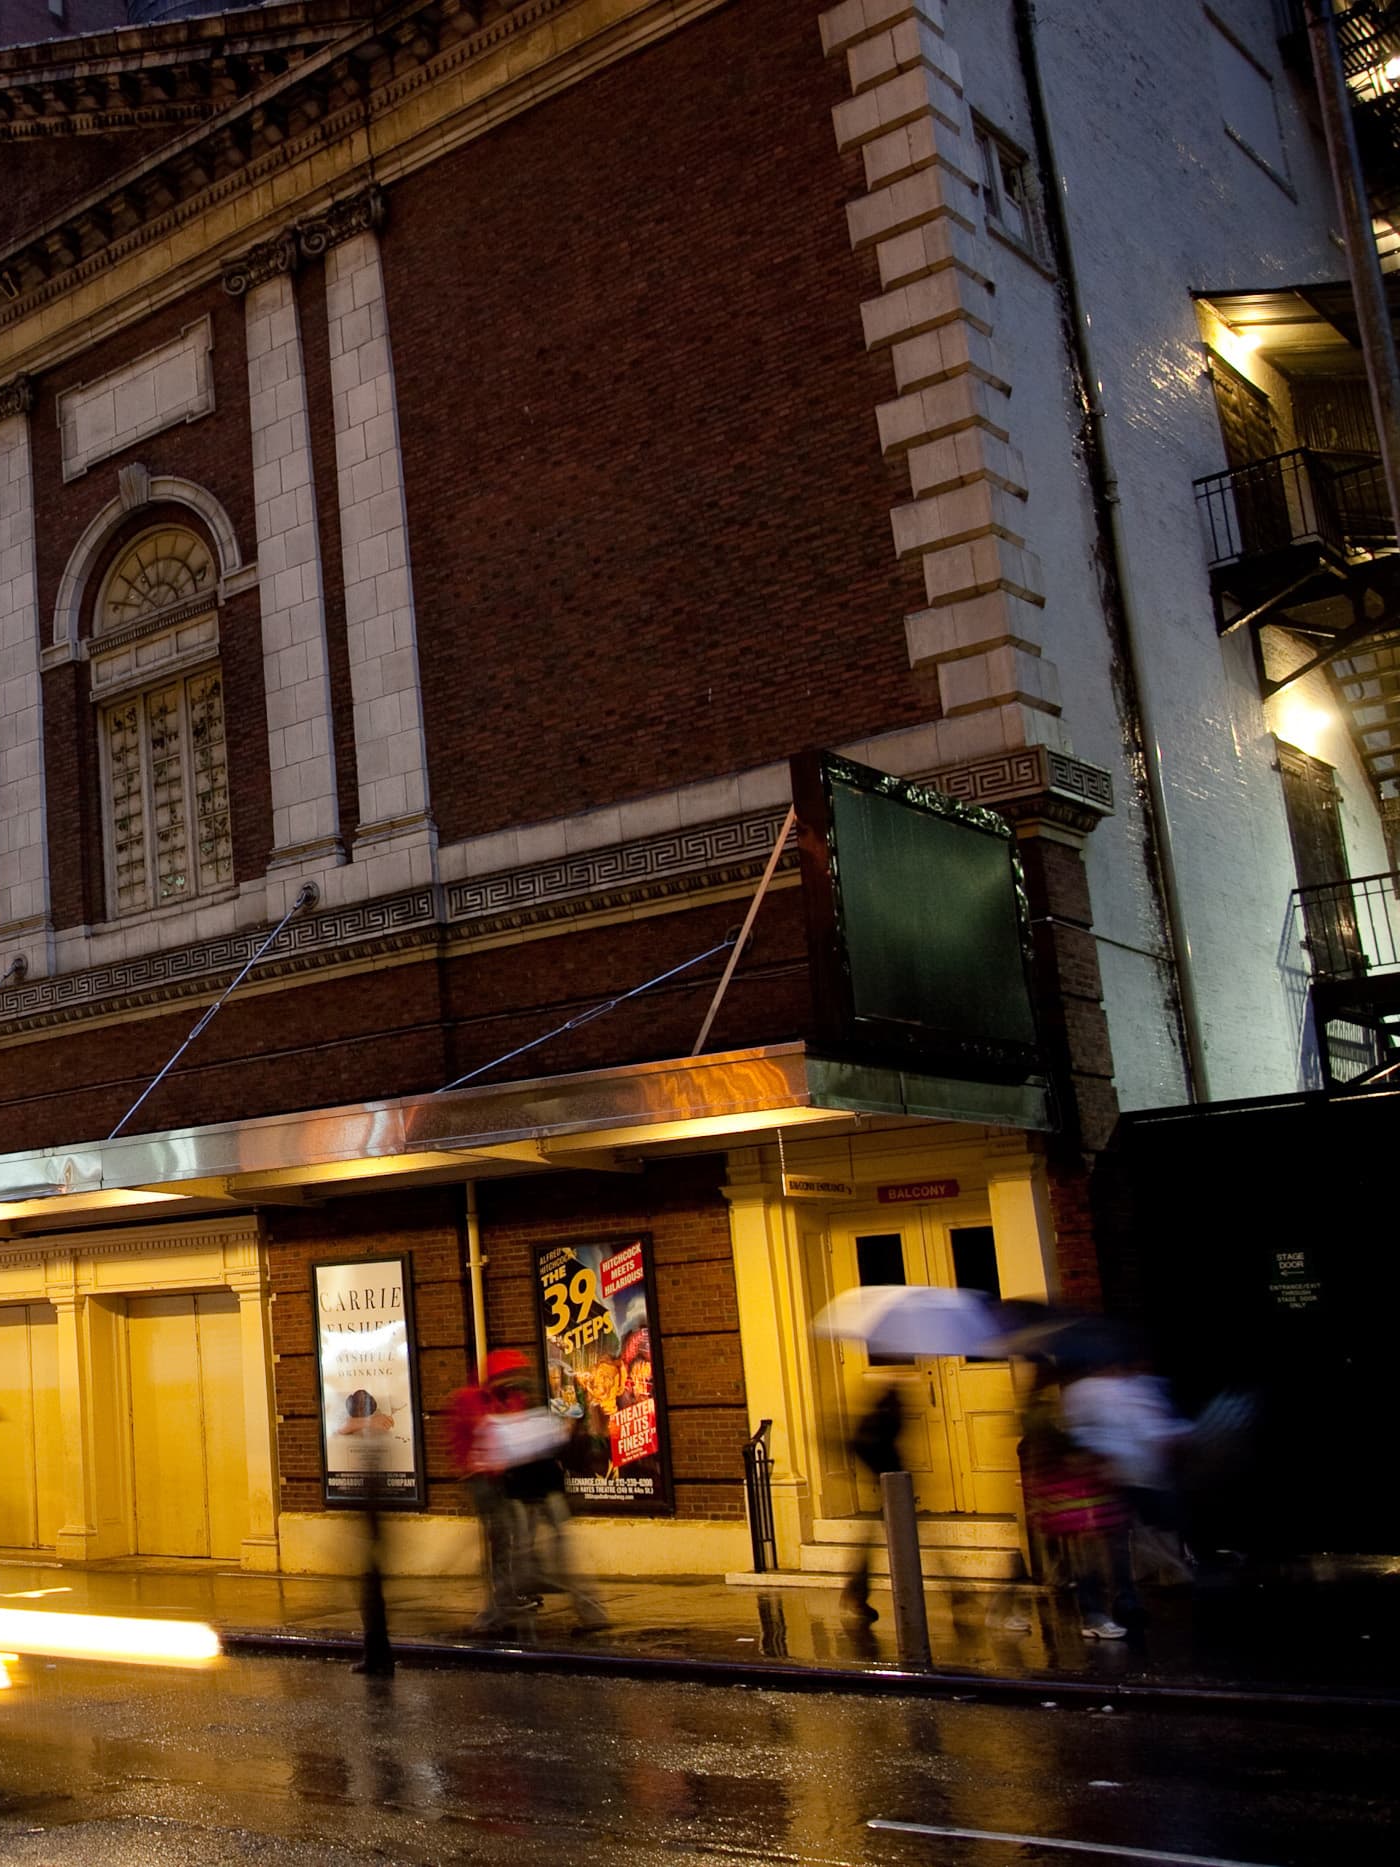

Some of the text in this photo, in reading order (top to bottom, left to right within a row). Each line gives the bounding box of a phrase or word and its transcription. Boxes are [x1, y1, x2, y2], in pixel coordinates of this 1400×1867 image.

[888, 1184, 945, 1199] BALCONY
[602, 1242, 642, 1272] HITCHCOCK
[1276, 1252, 1304, 1261] STAGE
[1279, 1261, 1304, 1269] DOOR
[541, 1265, 567, 1288] THE
[611, 1260, 635, 1280] MEETS
[604, 1267, 644, 1297] HILARIOUS!
[319, 1286, 402, 1313] CARRIE
[544, 1268, 598, 1337] 39
[563, 1310, 614, 1355] STEPS
[621, 1415, 649, 1439] AT ITS
[387, 1478, 416, 1488] COMPANY
